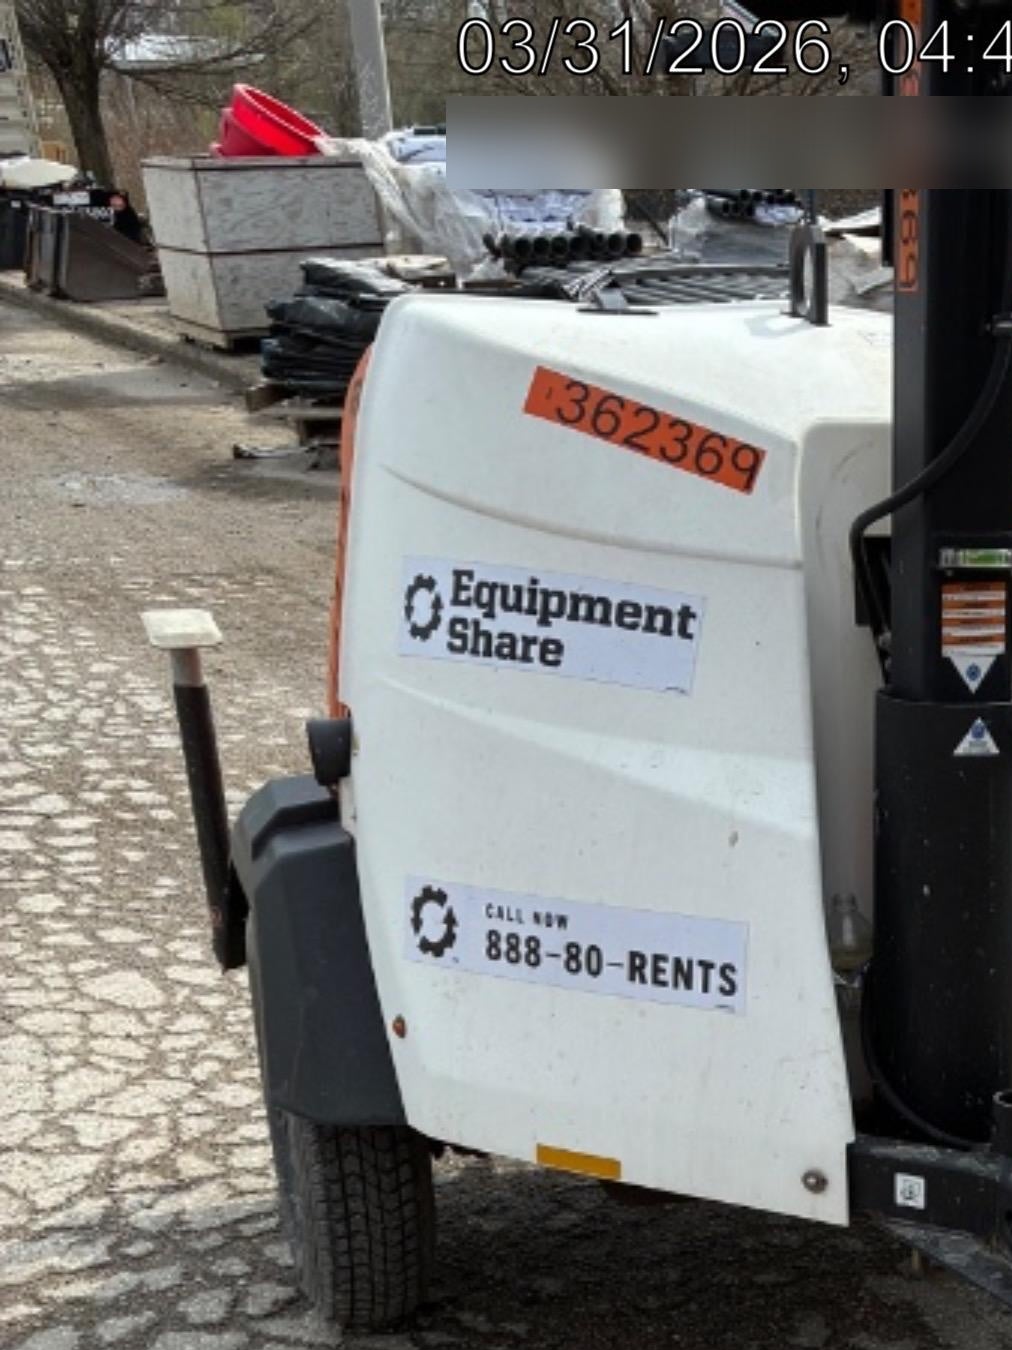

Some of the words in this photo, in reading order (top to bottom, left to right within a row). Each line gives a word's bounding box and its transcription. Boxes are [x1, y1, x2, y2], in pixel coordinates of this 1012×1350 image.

[556, 380, 761, 491] 362369
[449, 568, 698, 641] Equipment
[446, 616, 565, 668] Share
[485, 902, 525, 926] CALL
[532, 910, 569, 931] NOW
[485, 928, 738, 998] 888-80-RENTS
